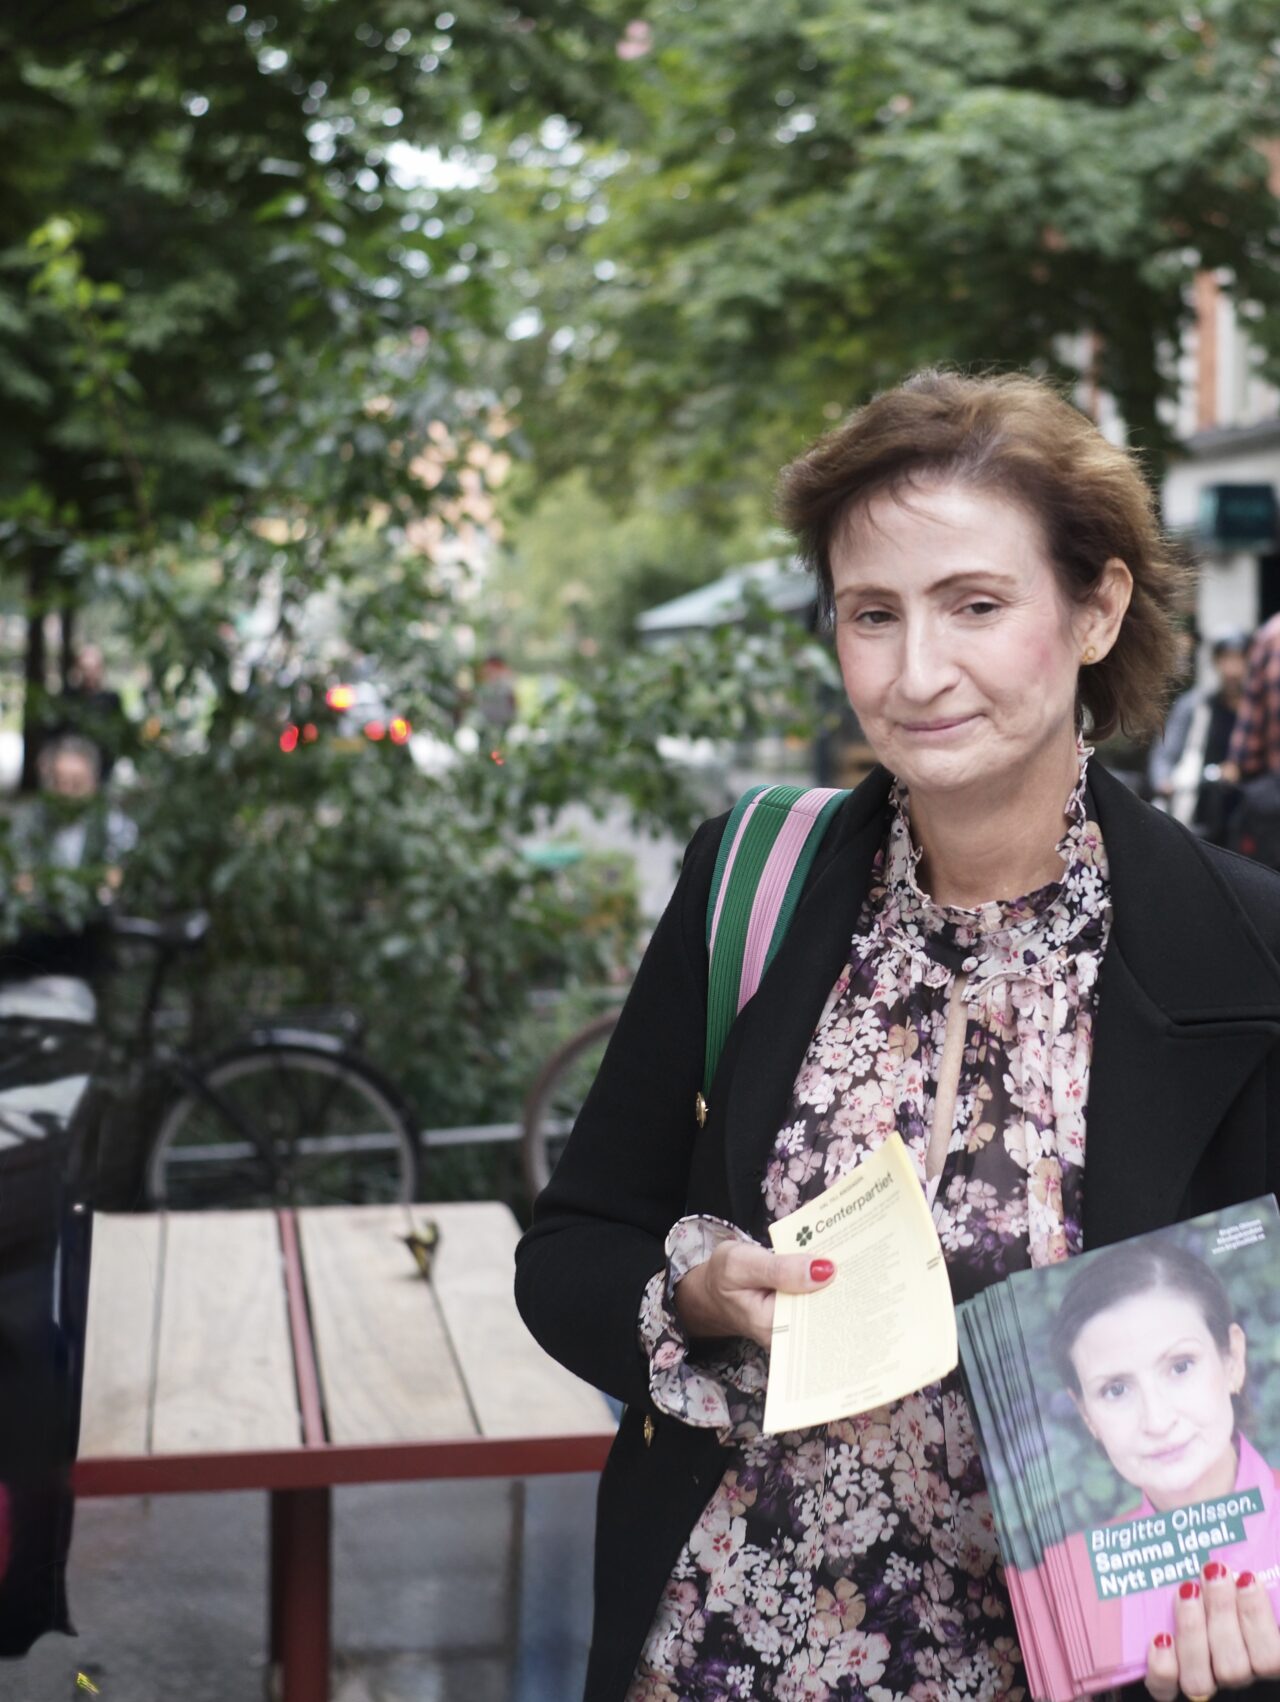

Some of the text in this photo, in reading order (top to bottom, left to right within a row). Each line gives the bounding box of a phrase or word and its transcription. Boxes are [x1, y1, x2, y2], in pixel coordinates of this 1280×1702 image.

[815, 1172, 894, 1234] Centerpartiet
[1091, 1495, 1258, 1551] Birgitta Ohlsson.
[1095, 1520, 1236, 1574] Samma ideal.
[1100, 1568, 1148, 1597] Nytt
